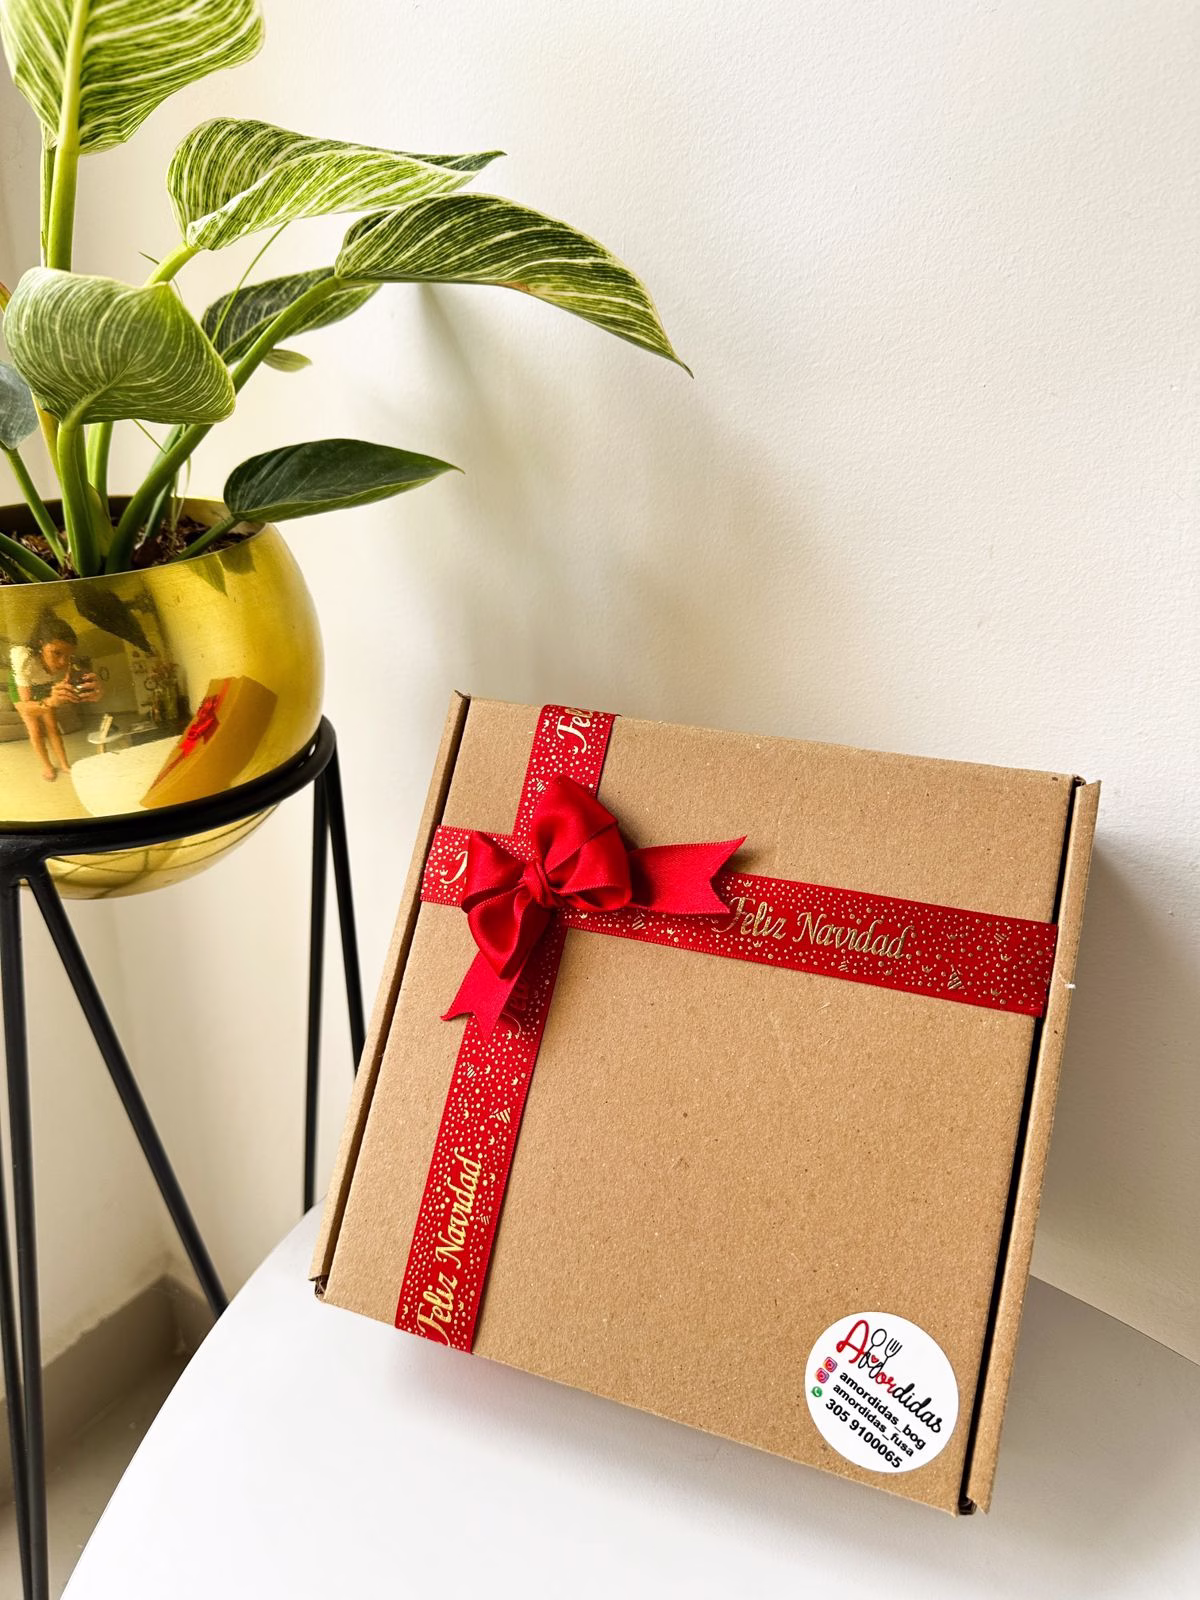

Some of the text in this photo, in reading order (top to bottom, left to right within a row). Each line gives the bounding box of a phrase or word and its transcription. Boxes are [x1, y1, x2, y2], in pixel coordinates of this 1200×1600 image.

[711, 896, 915, 960] Feliz Navidad
[417, 1147, 483, 1347] Feliz Navidad
[825, 1398, 903, 1468] 305 9100065
[832, 1384, 914, 1457] amordidas_fusa
[839, 1371, 926, 1450] amordidas_bog
